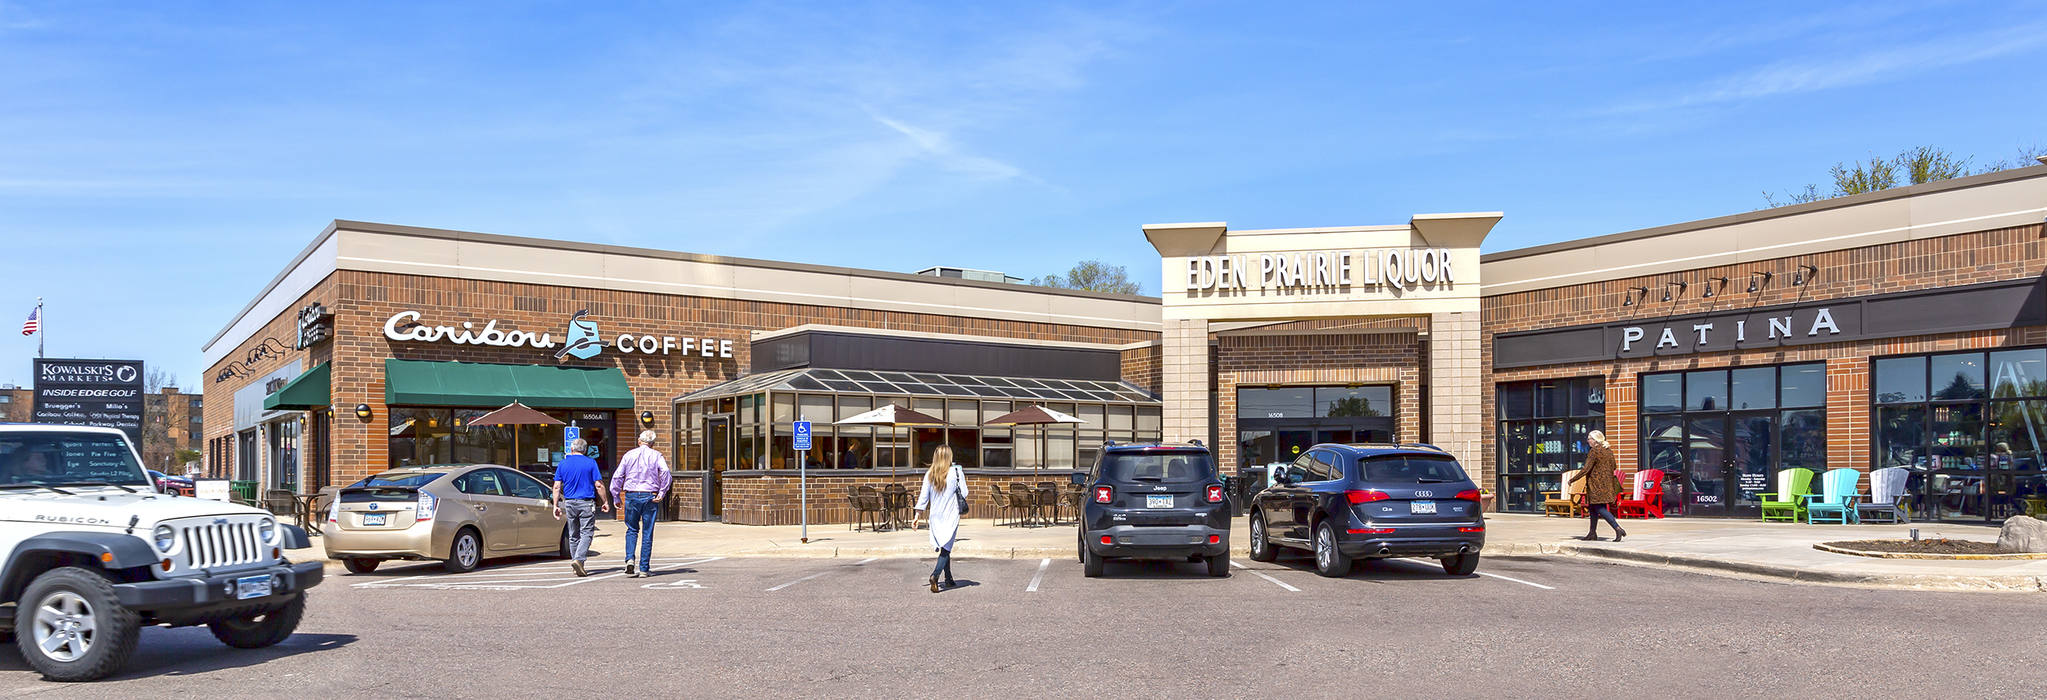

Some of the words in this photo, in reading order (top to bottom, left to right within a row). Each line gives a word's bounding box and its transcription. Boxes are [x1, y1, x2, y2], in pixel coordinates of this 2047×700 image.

[1186, 255, 1247, 290] EDEN
[1260, 251, 1352, 288] PRAIRIE
[1363, 248, 1454, 289] LIQUOR
[383, 310, 555, 349] Caribou
[616, 333, 733, 359] COFFEE
[1623, 308, 1841, 351] PATINA
[42, 363, 113, 376] KOWALSKI'S
[42, 389, 78, 397] INSIDE
[78, 389, 109, 397] EDGE
[109, 389, 137, 397] GOLF
[35, 514, 110, 524] RUBICON
